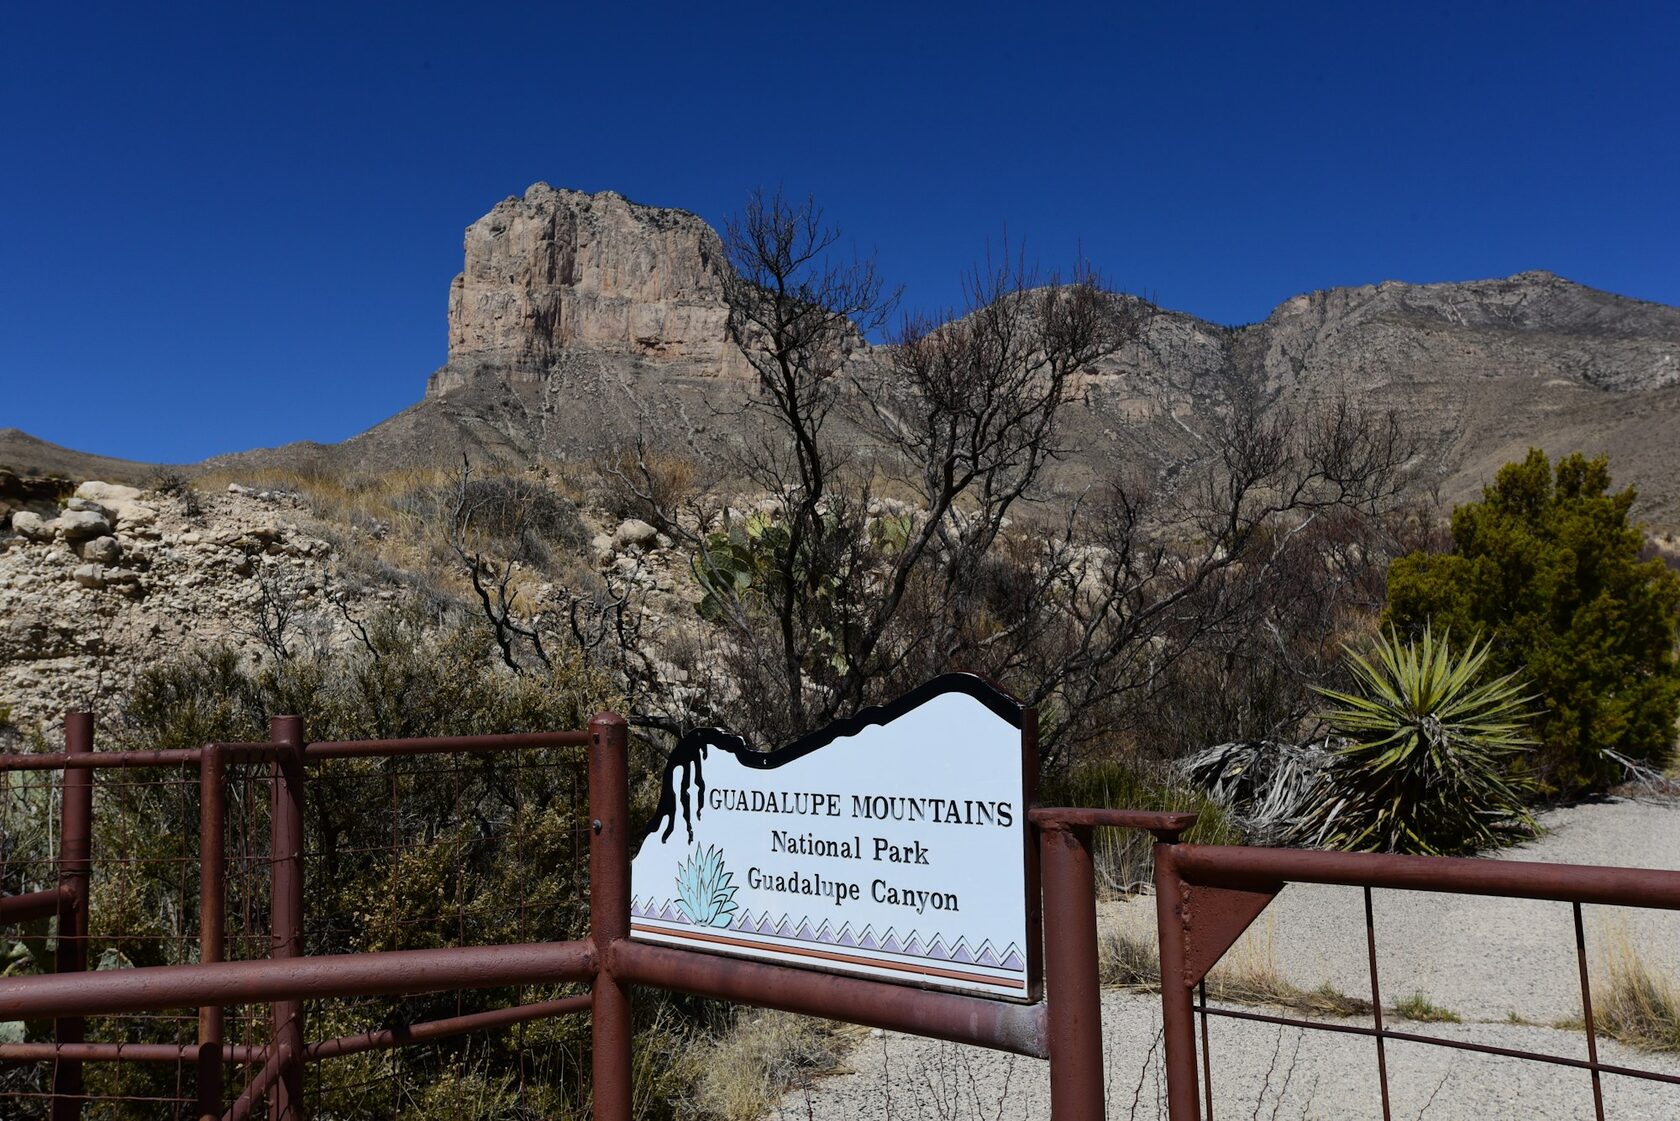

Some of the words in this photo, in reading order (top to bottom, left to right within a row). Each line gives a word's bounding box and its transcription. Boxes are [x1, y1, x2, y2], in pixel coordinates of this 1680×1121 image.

[709, 788, 841, 817] GUADALUPE
[851, 795, 1013, 828] MOUNTAINS
[771, 830, 862, 860] National
[872, 837, 930, 865] Park
[747, 866, 860, 906] Guadalupe
[871, 878, 960, 915] Canyon
